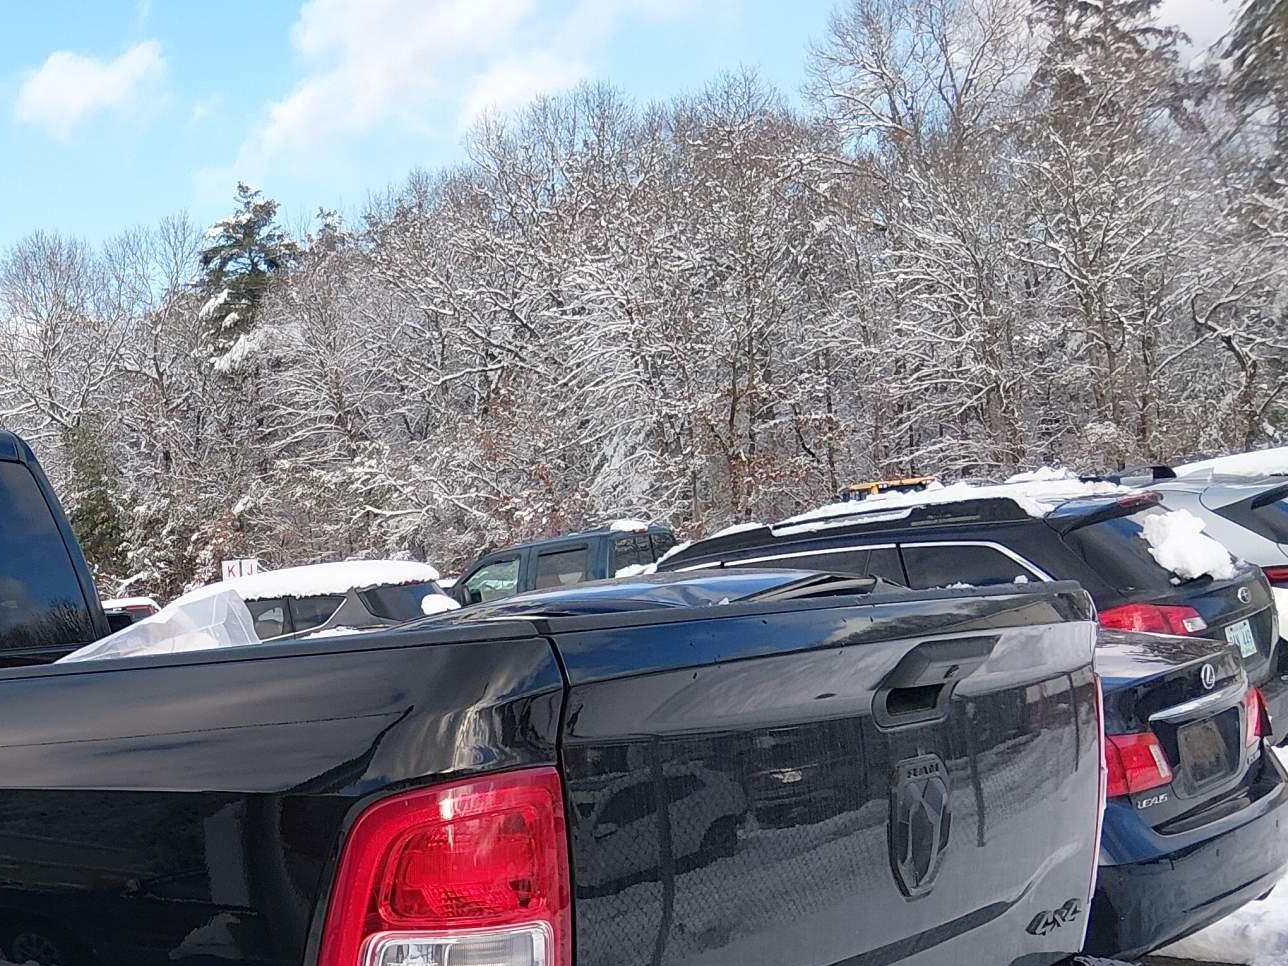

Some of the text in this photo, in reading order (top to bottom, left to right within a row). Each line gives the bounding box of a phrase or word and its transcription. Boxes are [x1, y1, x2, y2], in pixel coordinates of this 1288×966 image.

[227, 566, 236, 577] K
[906, 763, 940, 779] RAM
[1137, 793, 1169, 810] LEXUS
